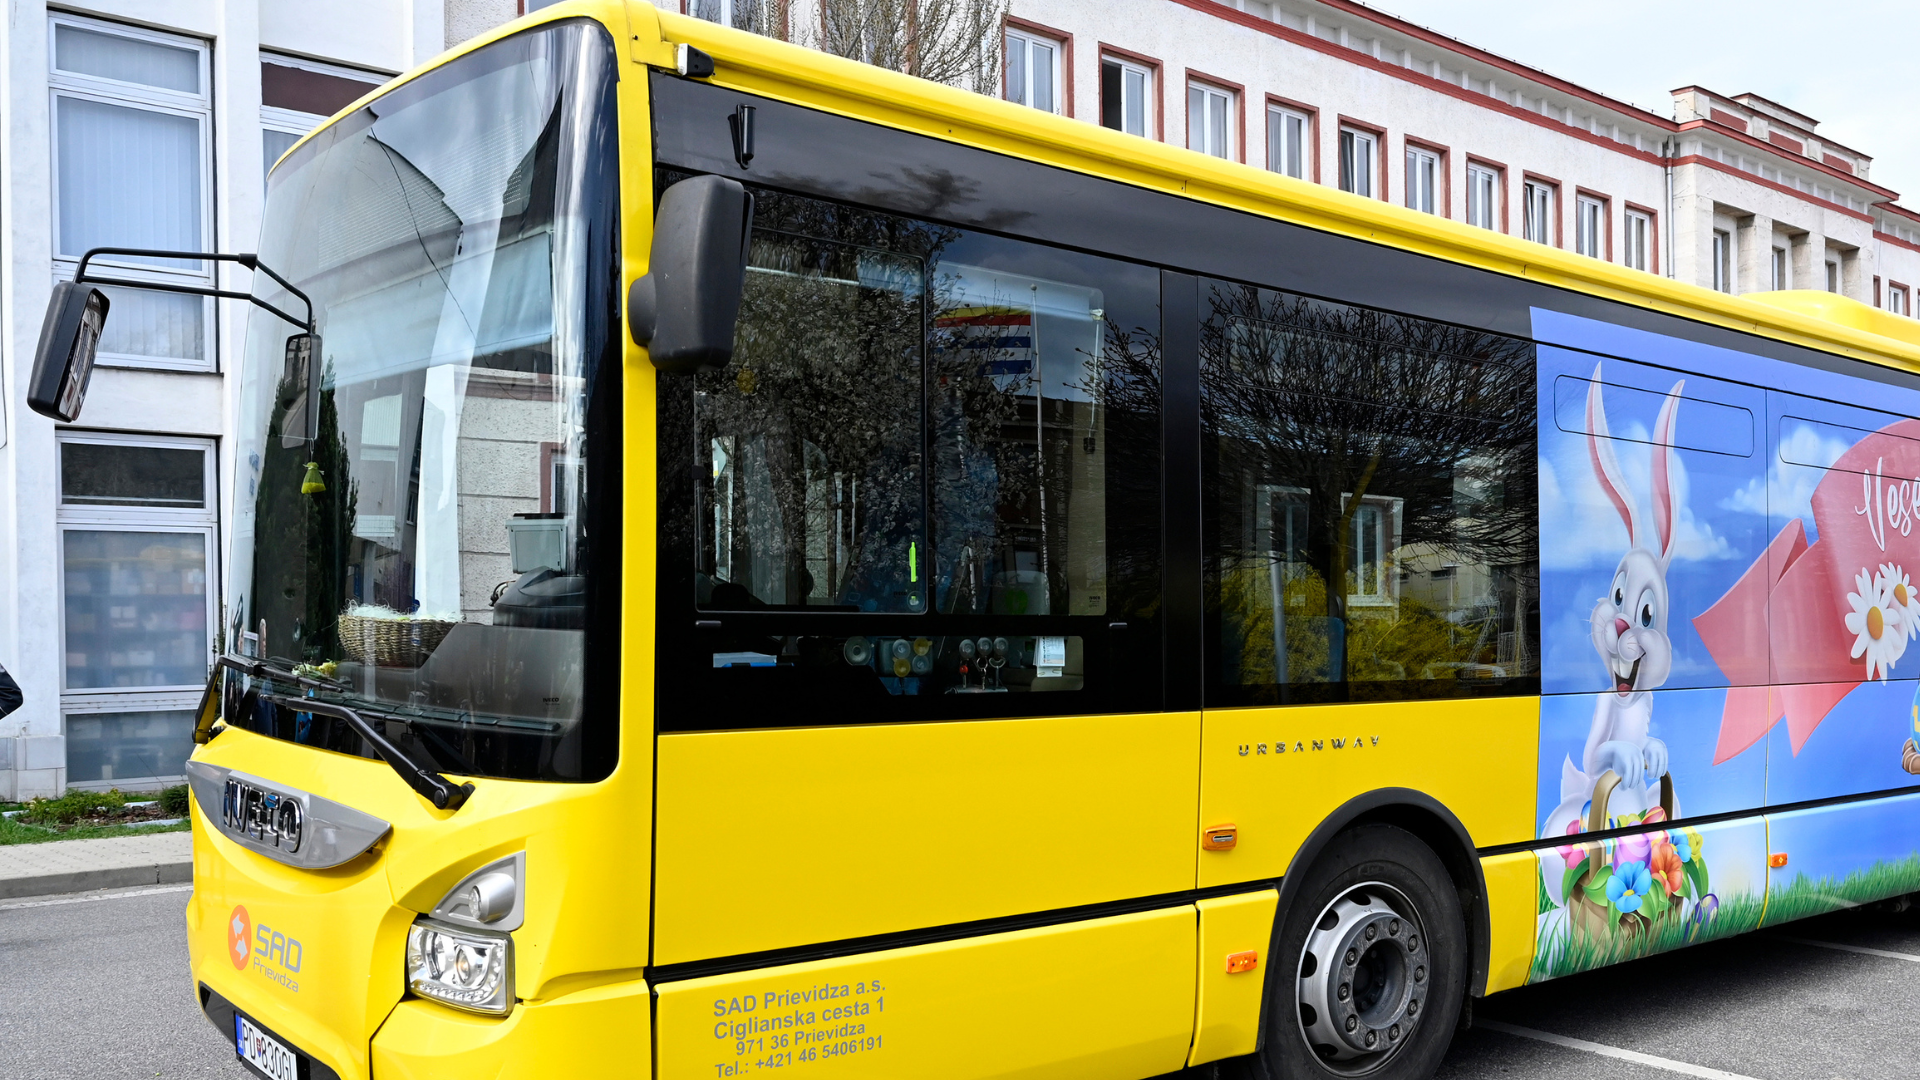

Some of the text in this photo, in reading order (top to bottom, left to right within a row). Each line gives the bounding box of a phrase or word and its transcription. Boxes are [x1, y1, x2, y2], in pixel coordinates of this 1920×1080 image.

[1238, 735, 1380, 756] URBANWAY
[255, 924, 303, 974] SAD
[253, 956, 299, 993] Prievidza
[713, 979, 887, 1017] SAD Prievidza a.s.
[714, 996, 884, 1041] Ciglianska cesta 1
[714, 1035, 882, 1079] Tel.: +421 46 5406191
[735, 1023, 866, 1056] 971 36 Prievidza
